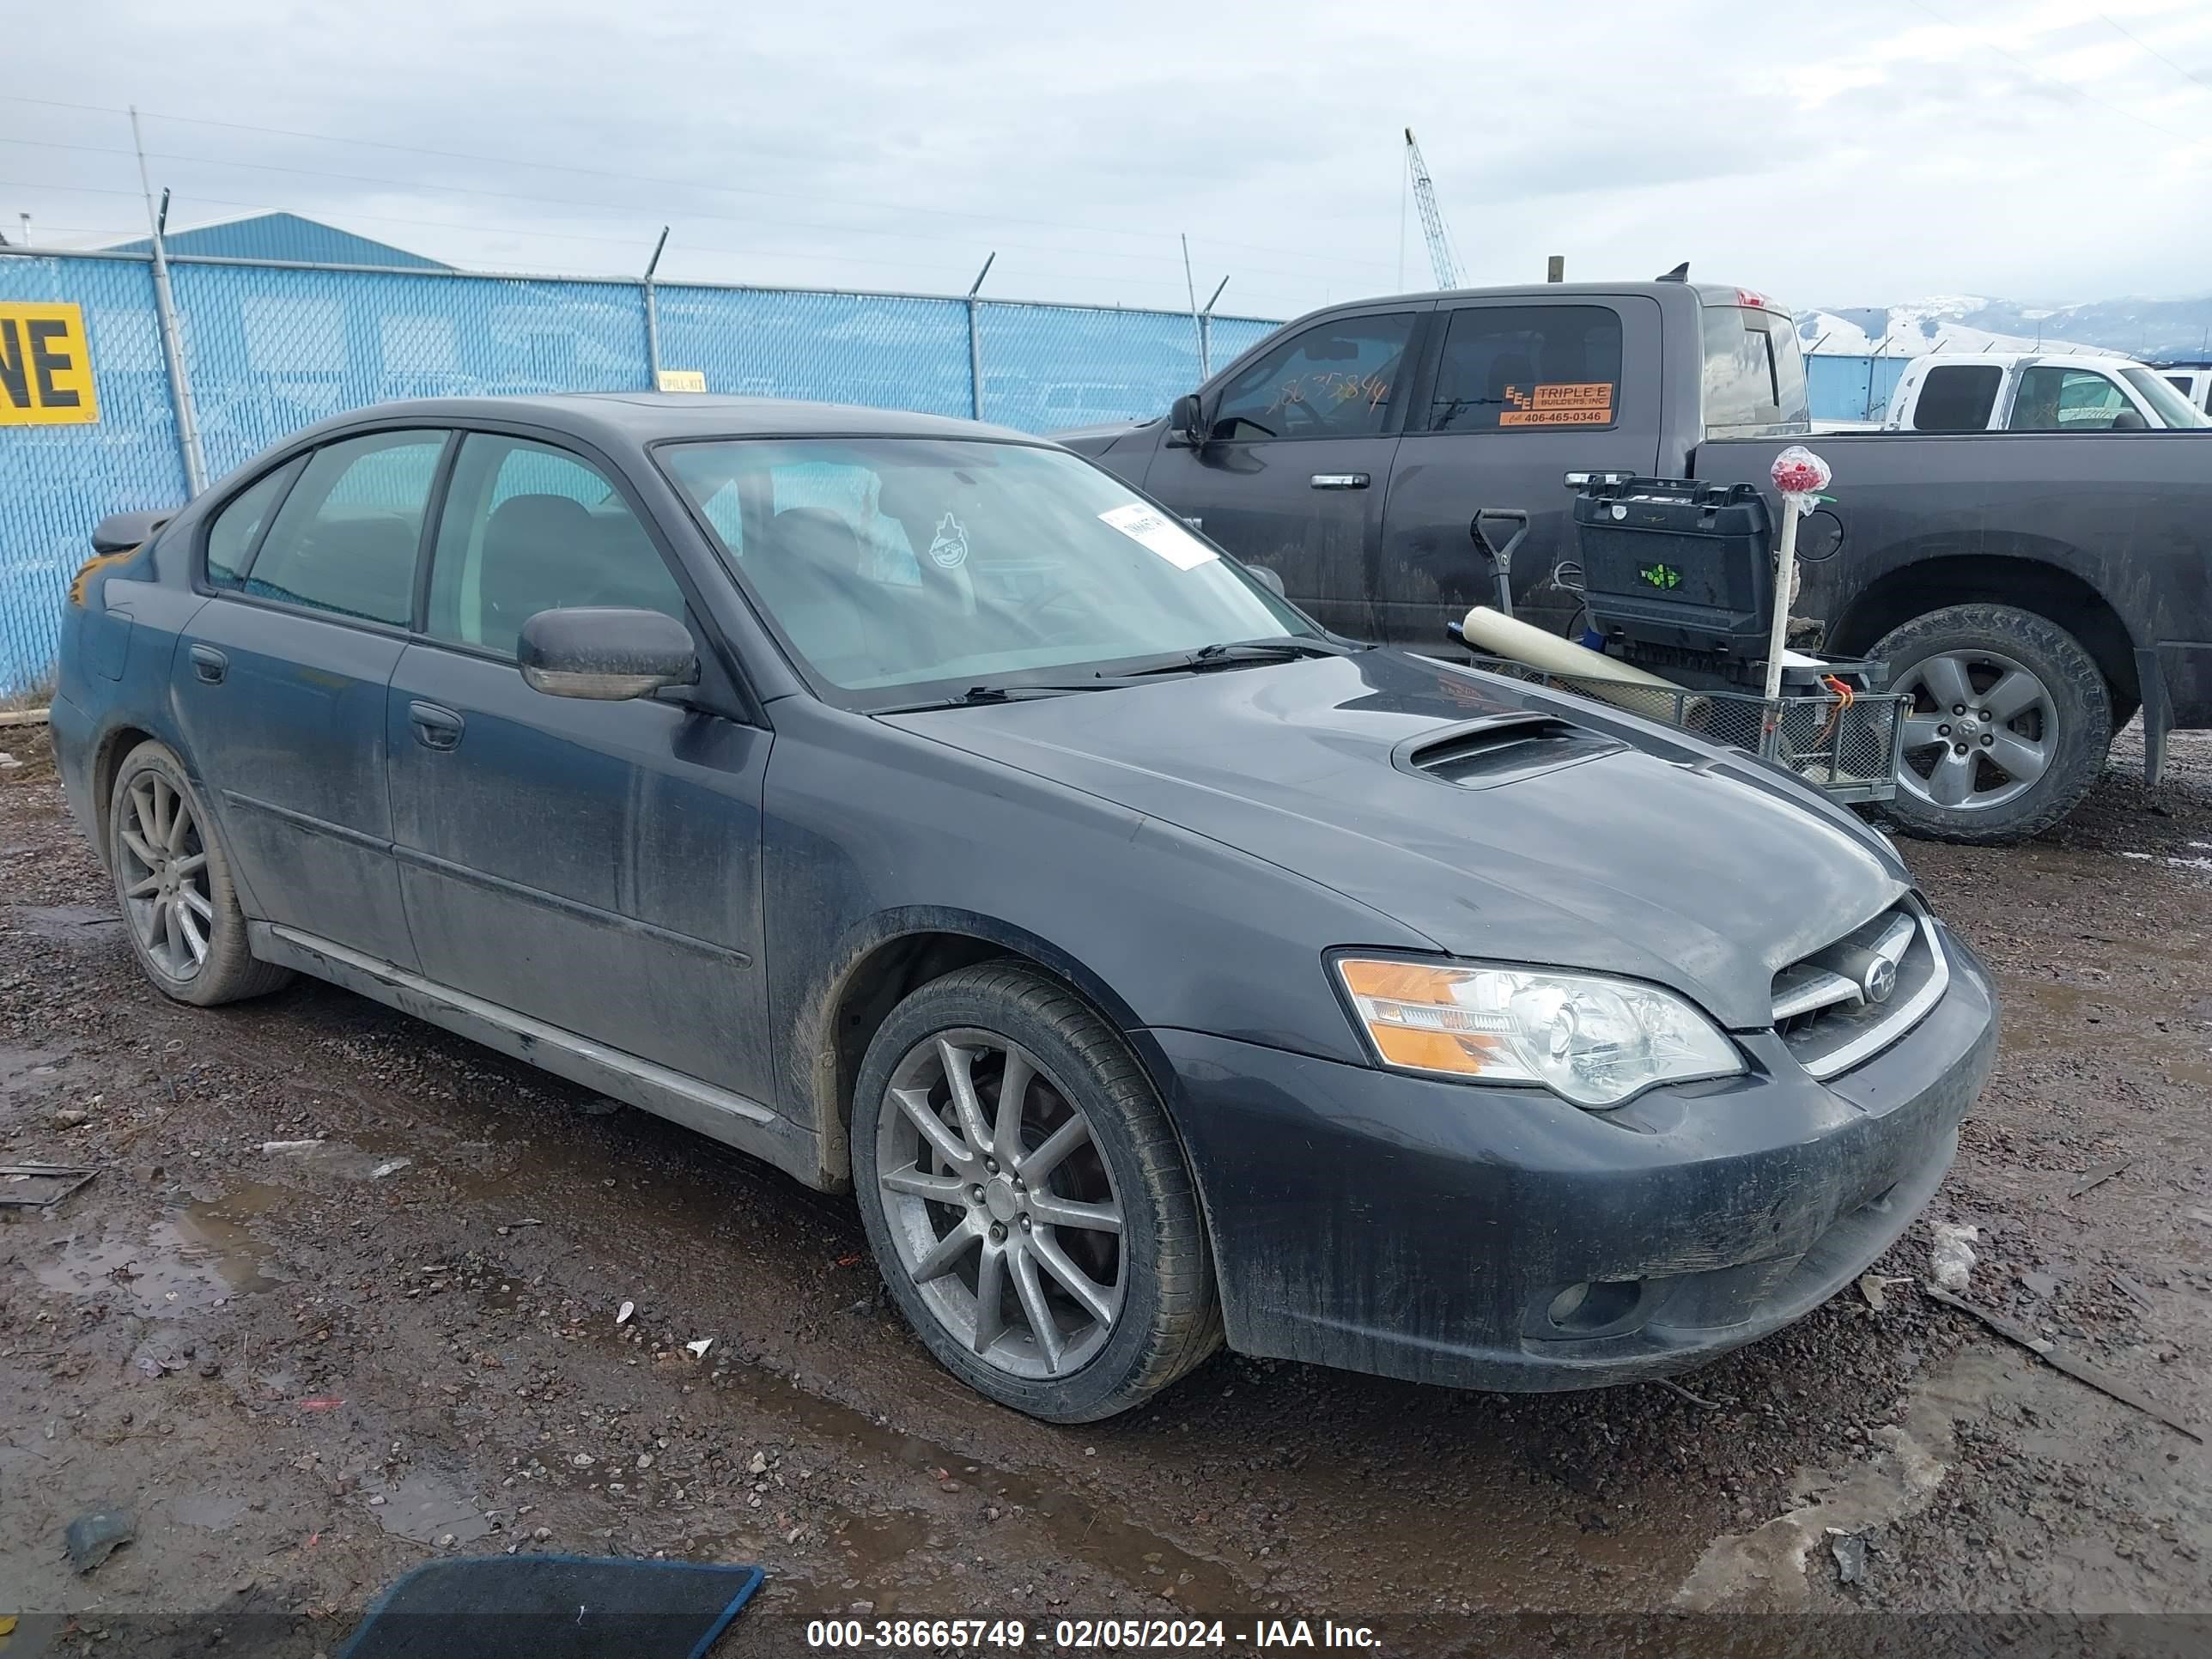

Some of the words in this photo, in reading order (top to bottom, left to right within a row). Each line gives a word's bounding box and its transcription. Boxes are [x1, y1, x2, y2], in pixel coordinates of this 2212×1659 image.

[1539, 387, 1594, 398] TRIPLE
[1596, 386, 1607, 397] E
[1524, 412, 1601, 422] 406-465-0346
